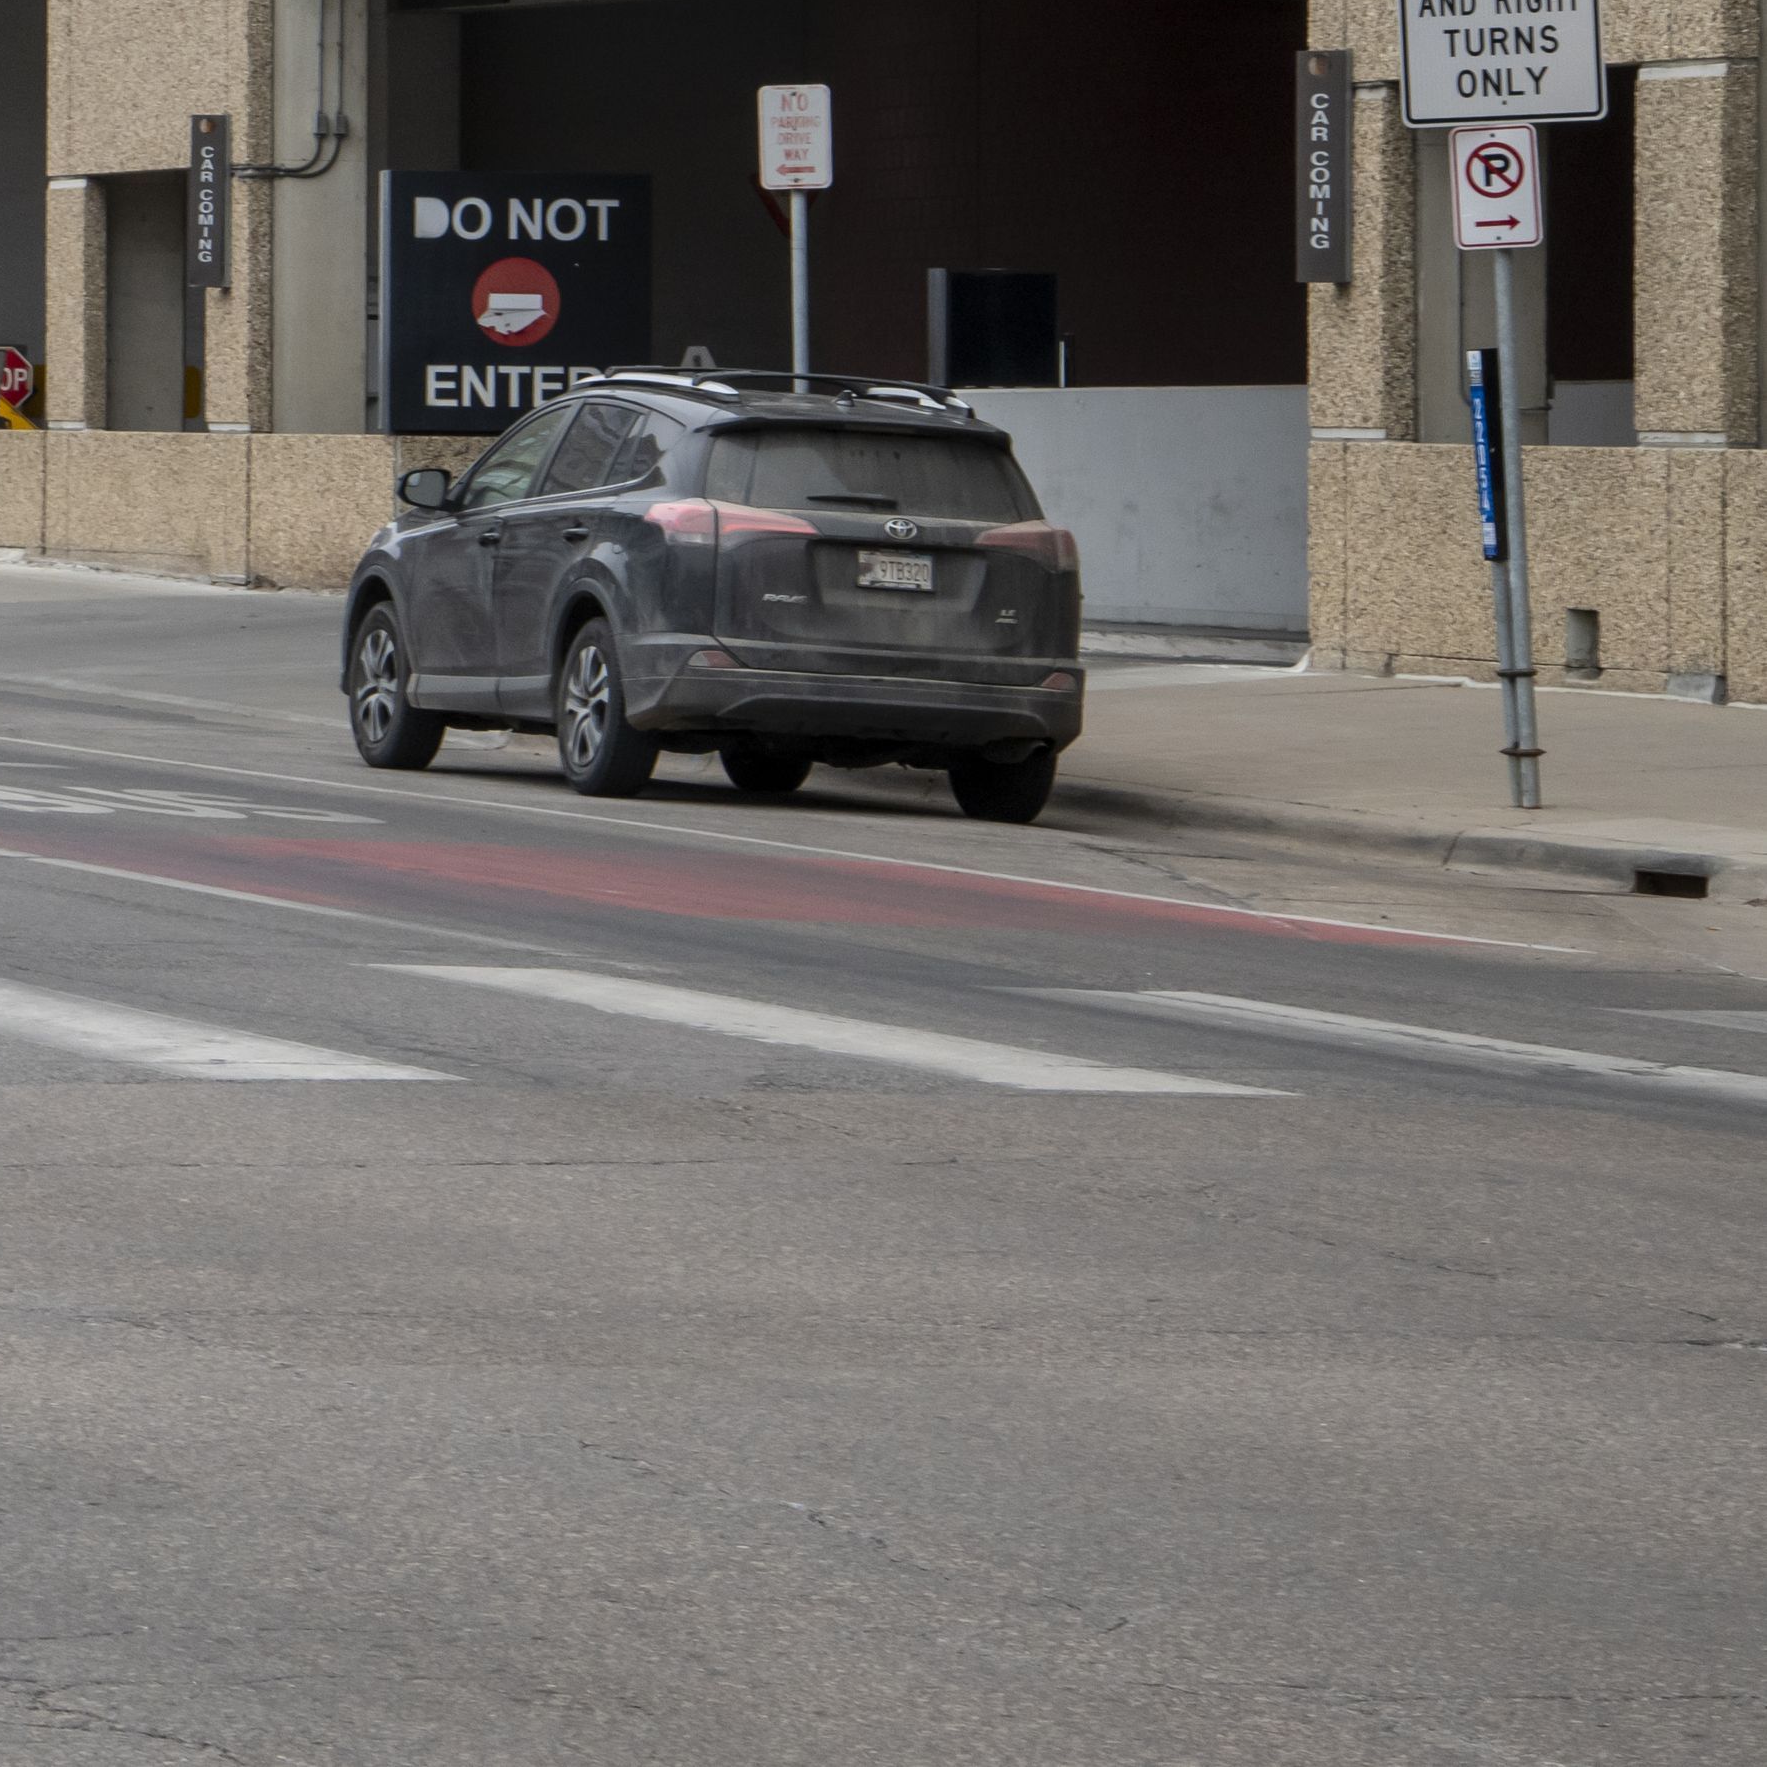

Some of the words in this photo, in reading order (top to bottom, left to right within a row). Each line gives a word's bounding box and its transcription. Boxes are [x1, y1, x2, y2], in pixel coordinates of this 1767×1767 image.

[1444, 25, 1559, 57] TURNS
[1457, 66, 1548, 98] ONLY
[781, 94, 809, 112] NO
[1309, 93, 1330, 141] CAR
[200, 146, 215, 182] CAR
[784, 149, 809, 161] WAY
[1309, 151, 1330, 249] COMING
[197, 189, 214, 263] COMING
[414, 197, 493, 240] DO
[508, 197, 620, 241] NOT
